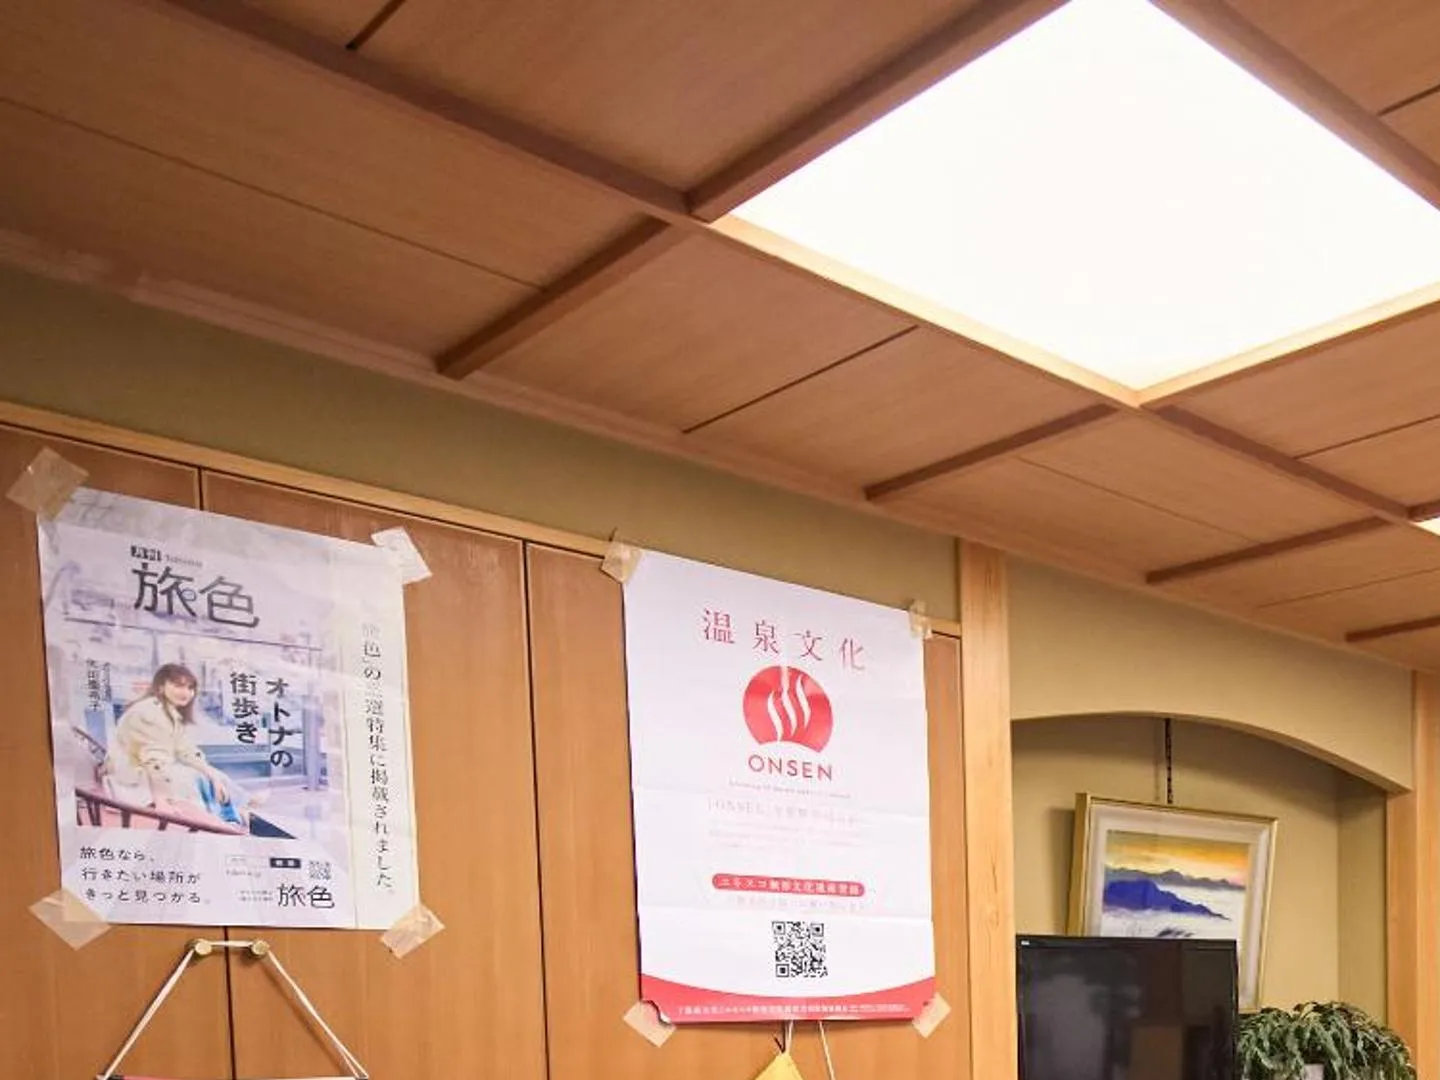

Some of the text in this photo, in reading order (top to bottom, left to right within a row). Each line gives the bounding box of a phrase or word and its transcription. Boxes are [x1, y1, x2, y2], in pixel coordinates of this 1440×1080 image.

[131, 562, 260, 628] 旅色
[702, 607, 867, 671] 温泉文化
[230, 671, 259, 744] 街歩き
[266, 677, 296, 768] オトナの
[748, 754, 832, 781] ONSEN
[80, 846, 155, 861] 旅色なら、
[82, 867, 200, 884] 行きたい場所が
[86, 888, 211, 904] きっと見つかる。
[277, 883, 335, 909] 旅色
